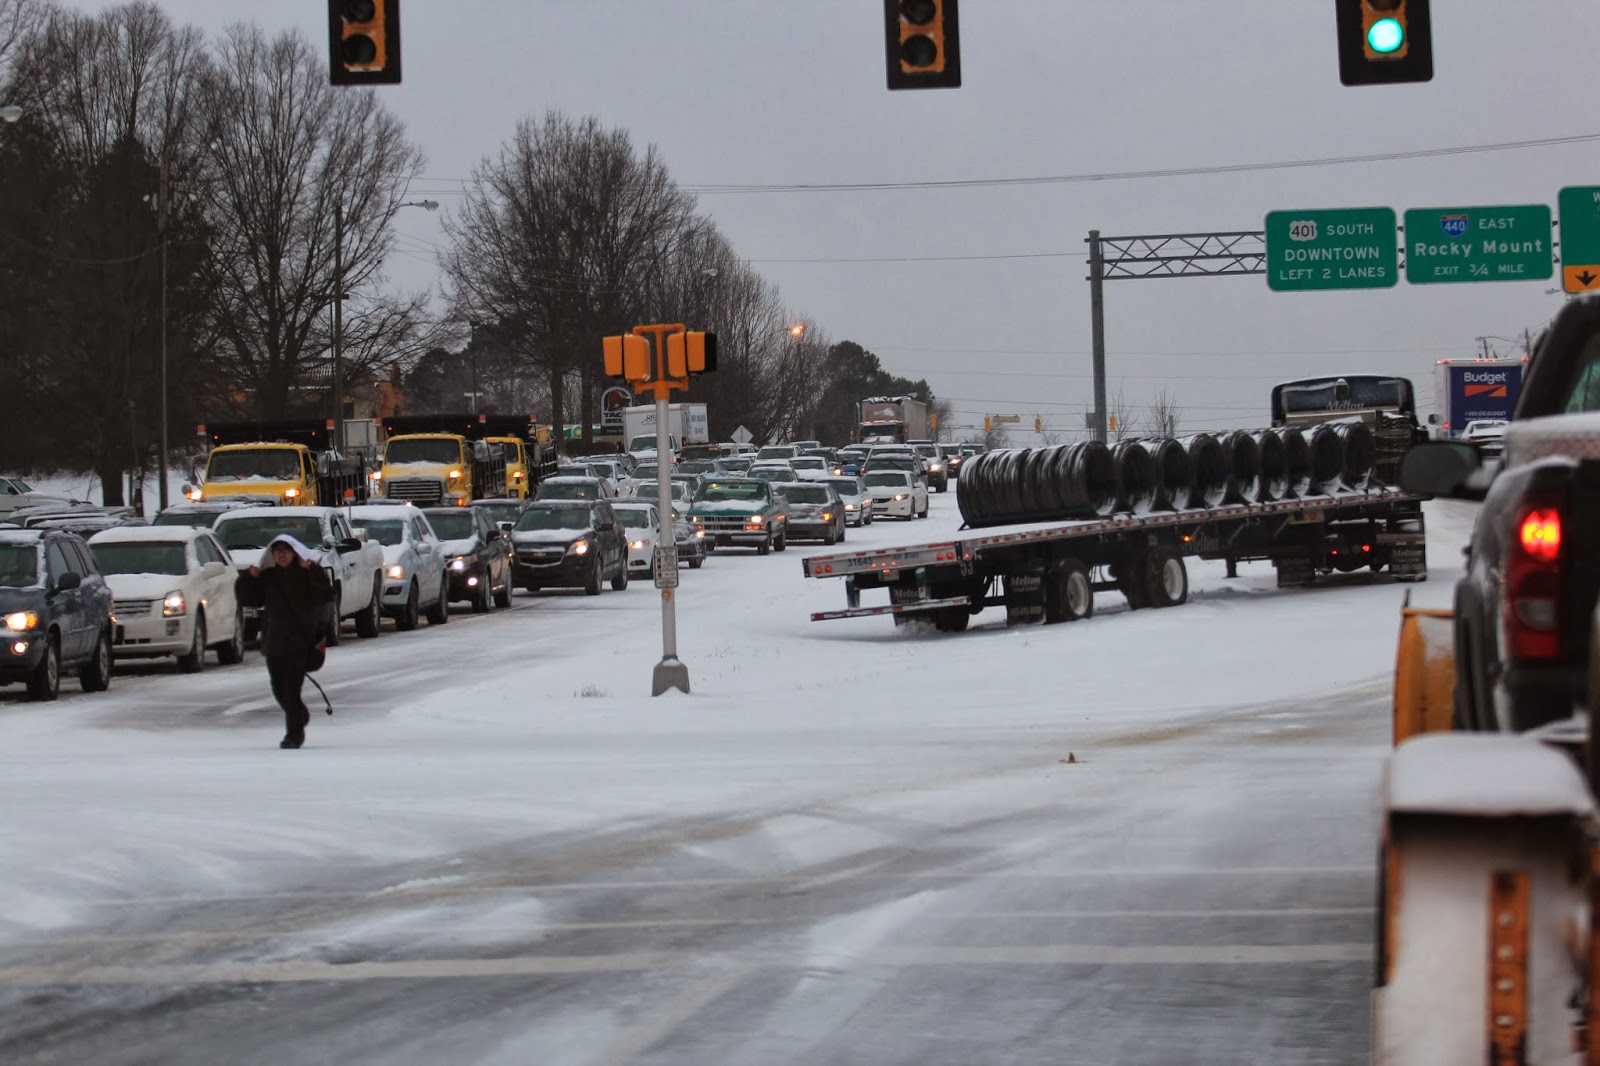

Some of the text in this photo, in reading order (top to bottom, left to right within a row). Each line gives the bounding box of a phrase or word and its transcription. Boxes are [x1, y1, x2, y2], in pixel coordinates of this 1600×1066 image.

[1291, 223, 1374, 237] 401 SOUTH
[1444, 218, 1515, 231] 440 EAST
[1284, 246, 1379, 261] DOWNTOWN
[1415, 239, 1542, 257] Rocky Mount
[1280, 266, 1386, 280] LEFT 2 LANES
[1434, 266, 1459, 275] EXIT
[1498, 264, 1524, 273] MILE
[1464, 372, 1507, 384] Budget
[1326, 400, 1364, 410] Melton
[847, 557, 872, 567] 31645
[1010, 575, 1041, 585] Melton
